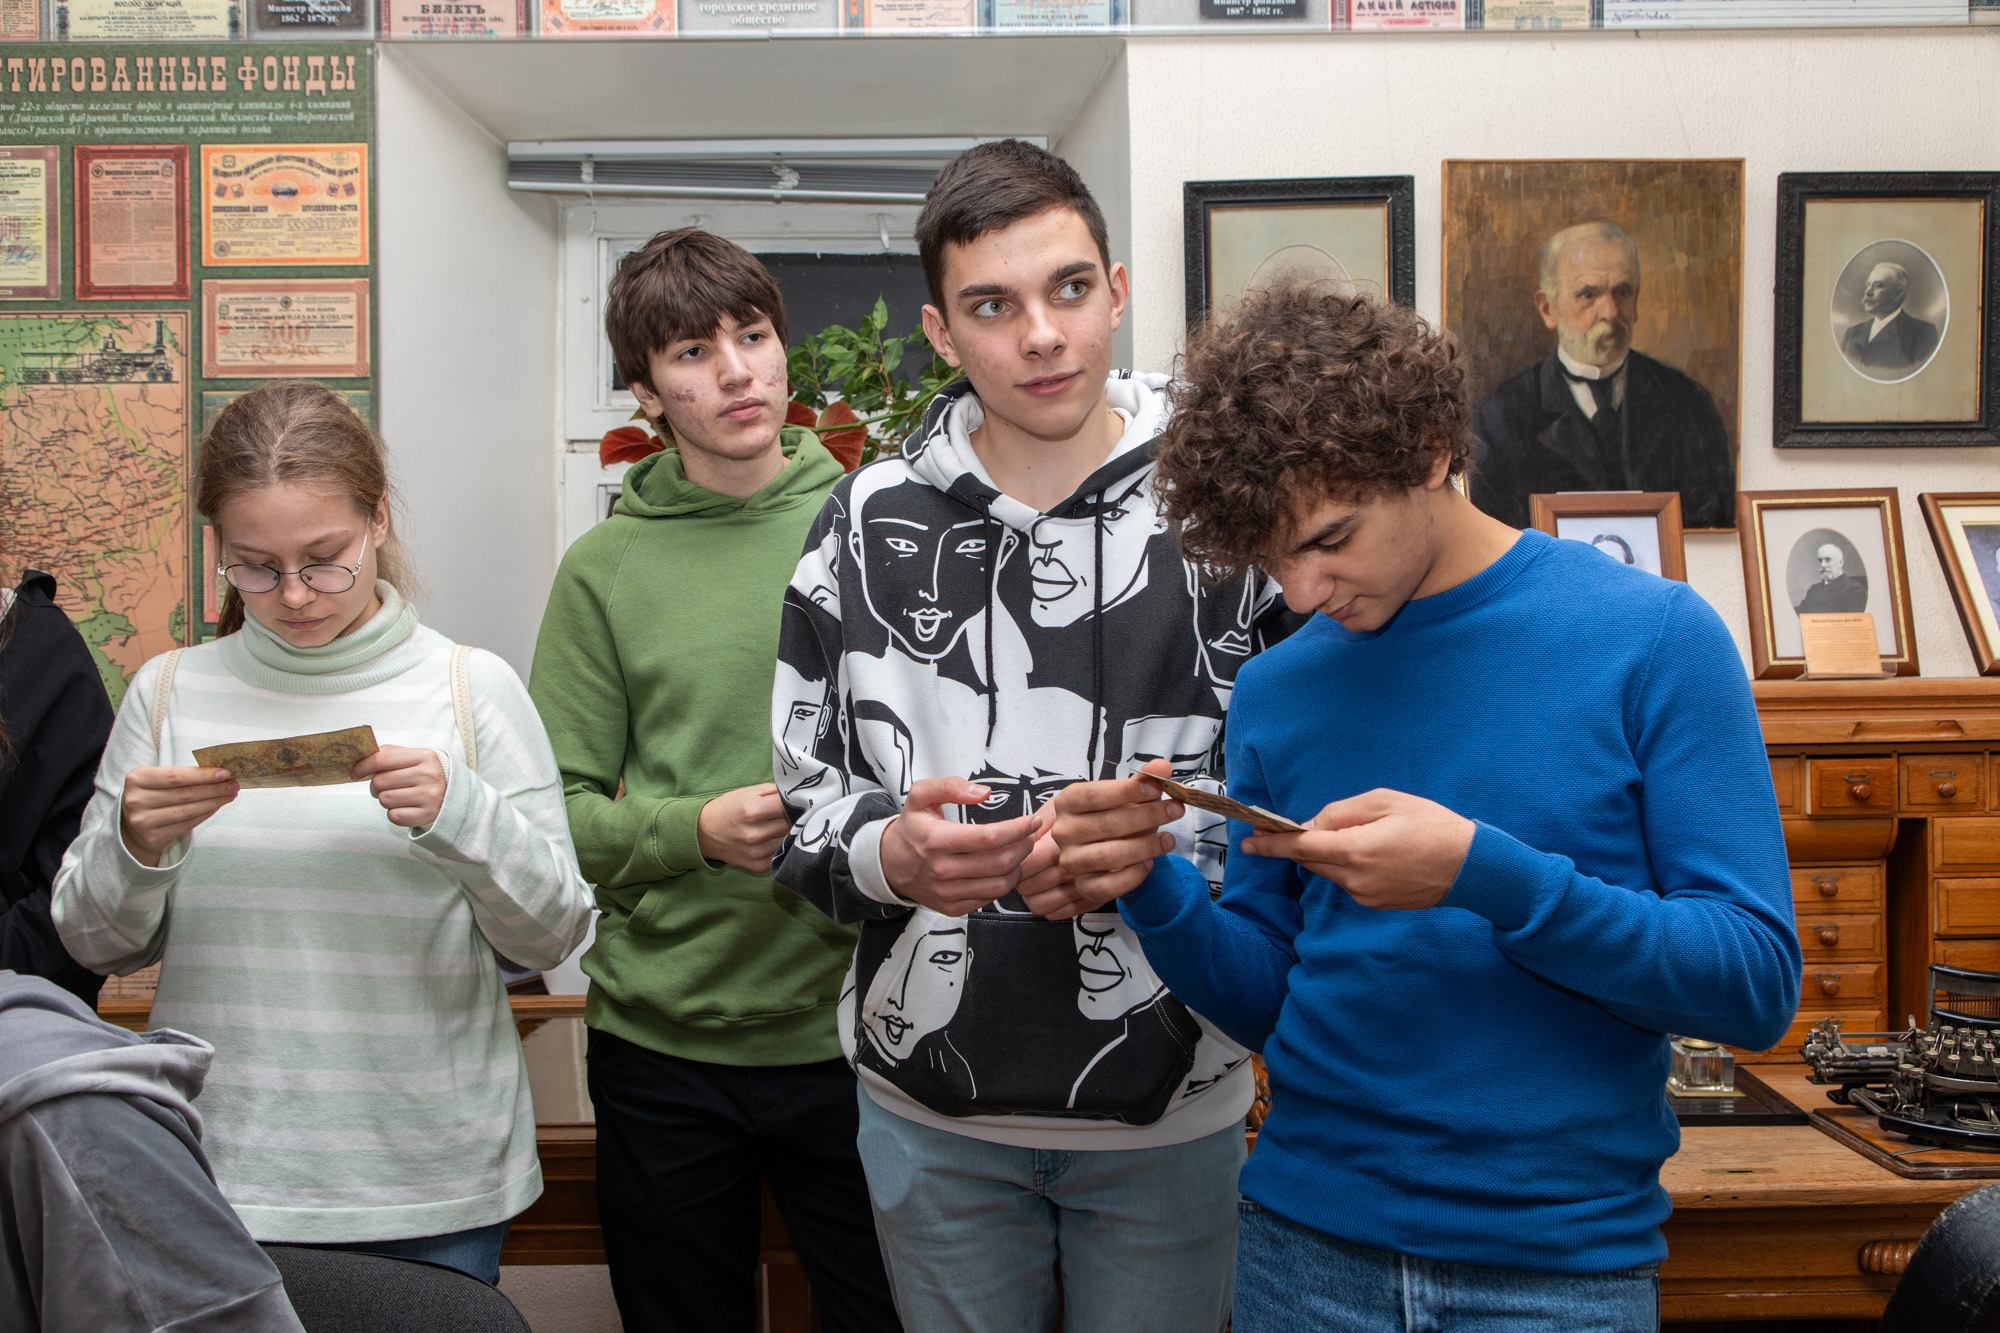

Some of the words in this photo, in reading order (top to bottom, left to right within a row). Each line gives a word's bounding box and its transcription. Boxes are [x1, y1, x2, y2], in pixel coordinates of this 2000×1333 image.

[267, 4, 307, 15] Министр
[308, 3, 352, 14] финансов
[420, 4, 486, 14] БИЛЕТЪ
[699, 3, 757, 14] городское
[758, 2, 817, 13] кредитное
[1226, 7, 1245, 16] 1887
[1252, 7, 1271, 16] 1892
[1272, 7, 1284, 16] гг.
[1410, 0, 1457, 11] ACTIONS
[281, 14, 301, 23] 1862
[731, 13, 785, 25] общество
[0, 56, 228, 93] ТИРОВАННЫЕ
[236, 55, 357, 97] ФОНДЫ
[20, 101, 42, 111] 22-х
[45, 101, 85, 113] обществ
[88, 102, 133, 111] железных
[136, 101, 162, 113] дорог
[166, 102, 173, 110] и
[0, 125, 81, 138] анско-Уральской)
[84, 127, 89, 135] с
[94, 125, 185, 138] правительственной
